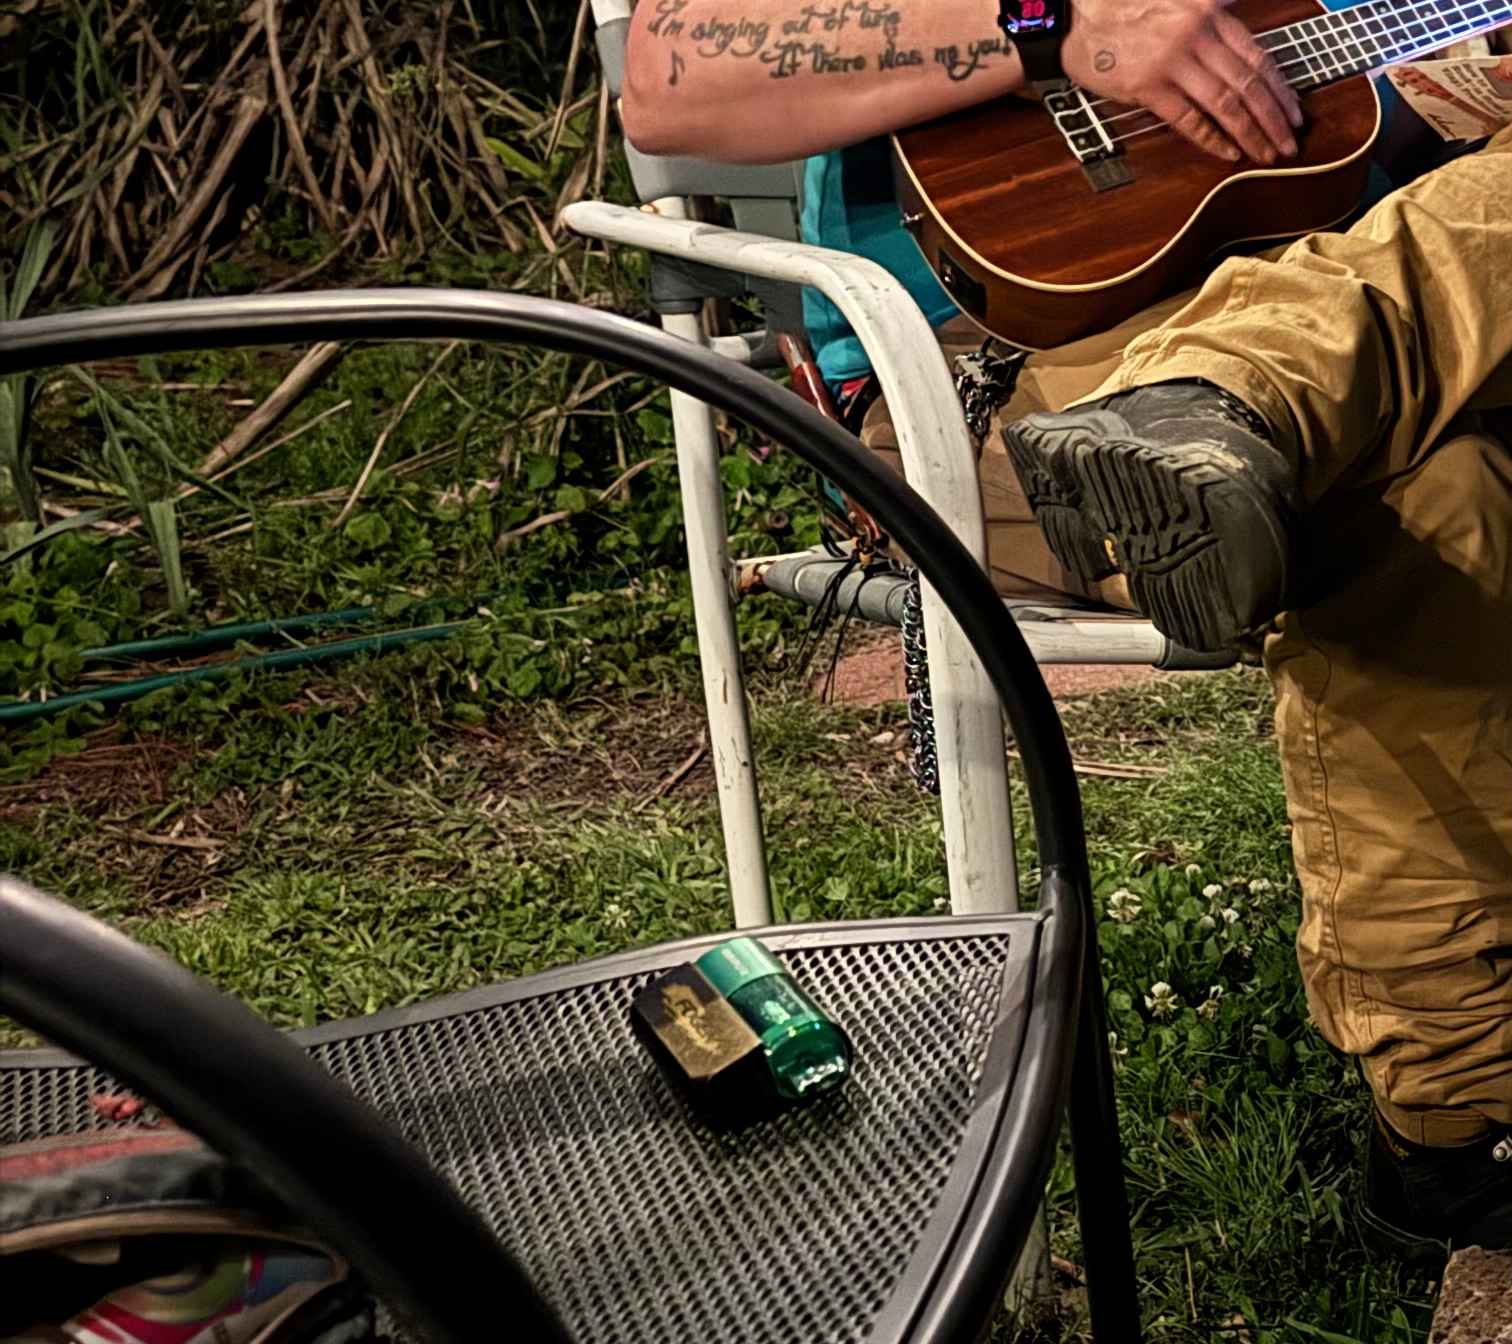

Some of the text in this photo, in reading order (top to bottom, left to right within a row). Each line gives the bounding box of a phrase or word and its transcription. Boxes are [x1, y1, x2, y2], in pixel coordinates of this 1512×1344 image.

[690, 15, 769, 58] singing
[782, 5, 836, 36] out
[803, 42, 867, 75] there
